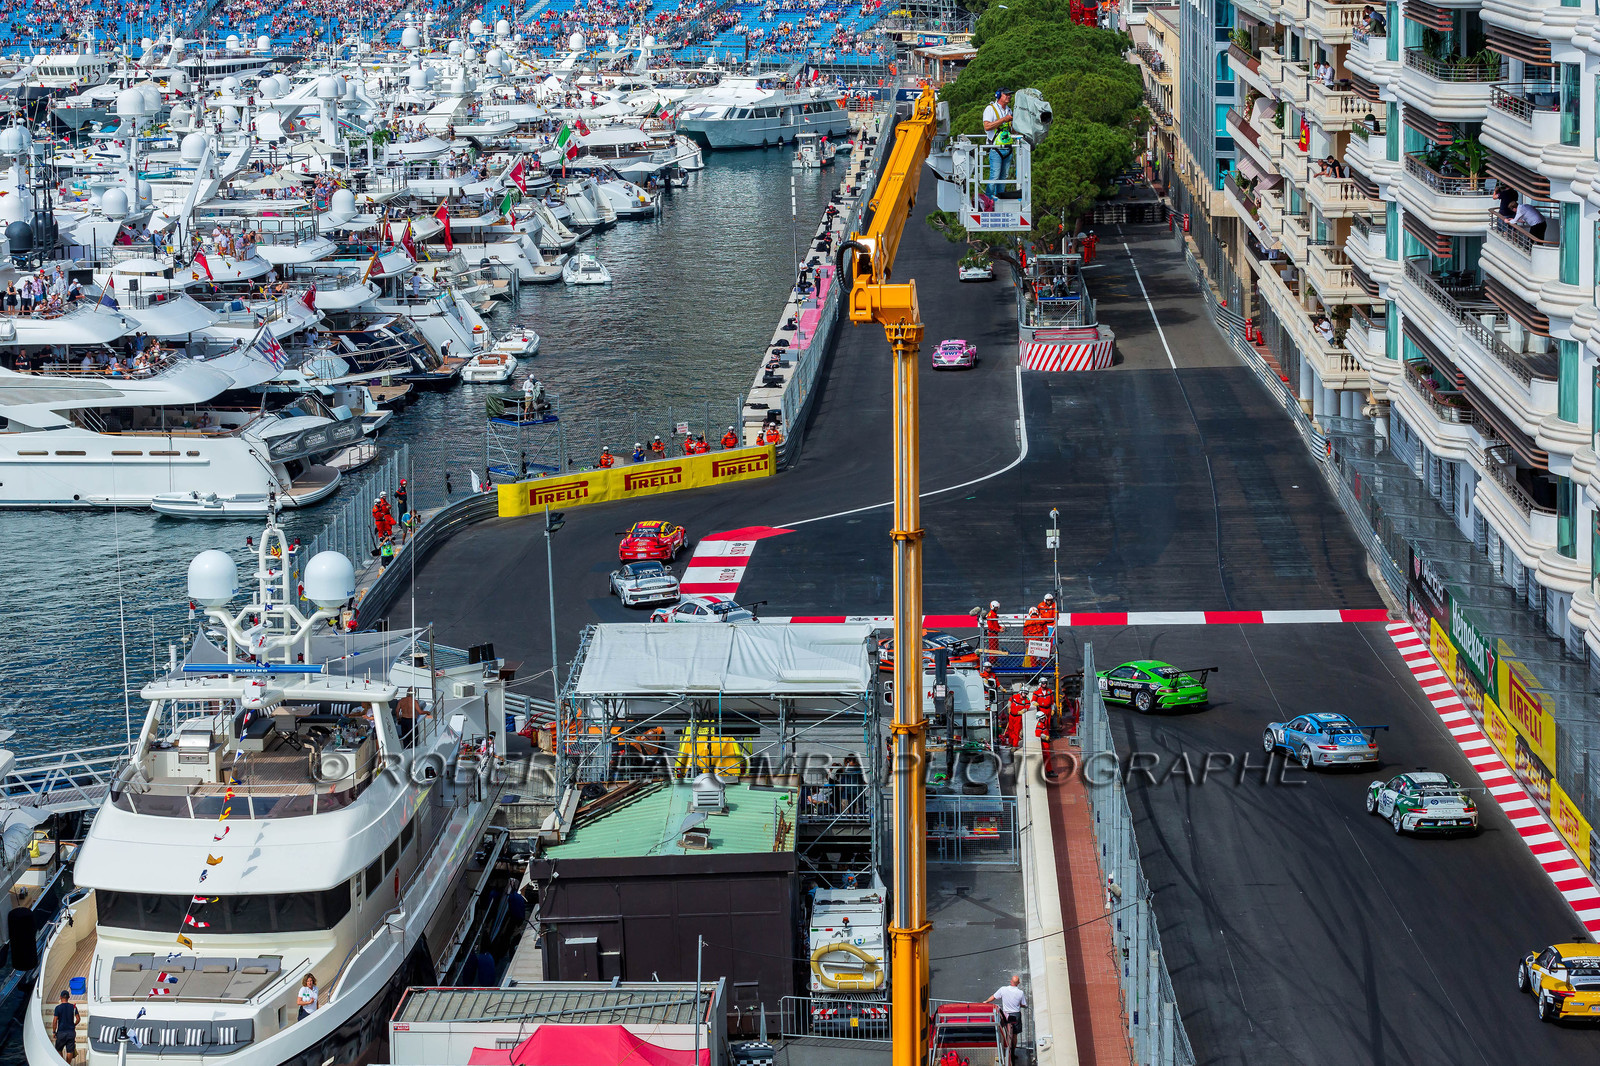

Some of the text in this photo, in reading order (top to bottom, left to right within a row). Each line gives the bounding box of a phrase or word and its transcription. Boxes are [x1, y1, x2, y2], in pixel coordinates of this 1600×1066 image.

[624, 466, 682, 491] PIRELLI
[712, 454, 768, 478] PIRELLI
[530, 480, 588, 506] PIRELLI
[1436, 632, 1449, 670] PIRELLI
[1452, 598, 1485, 676] Heineken
[1464, 677, 1482, 711] ZERO
[1509, 664, 1542, 748] PIRELLI
[1492, 710, 1507, 752] PIRELLI
[1526, 759, 1548, 800] ZERO
[1560, 799, 1579, 847] PIRELLI
